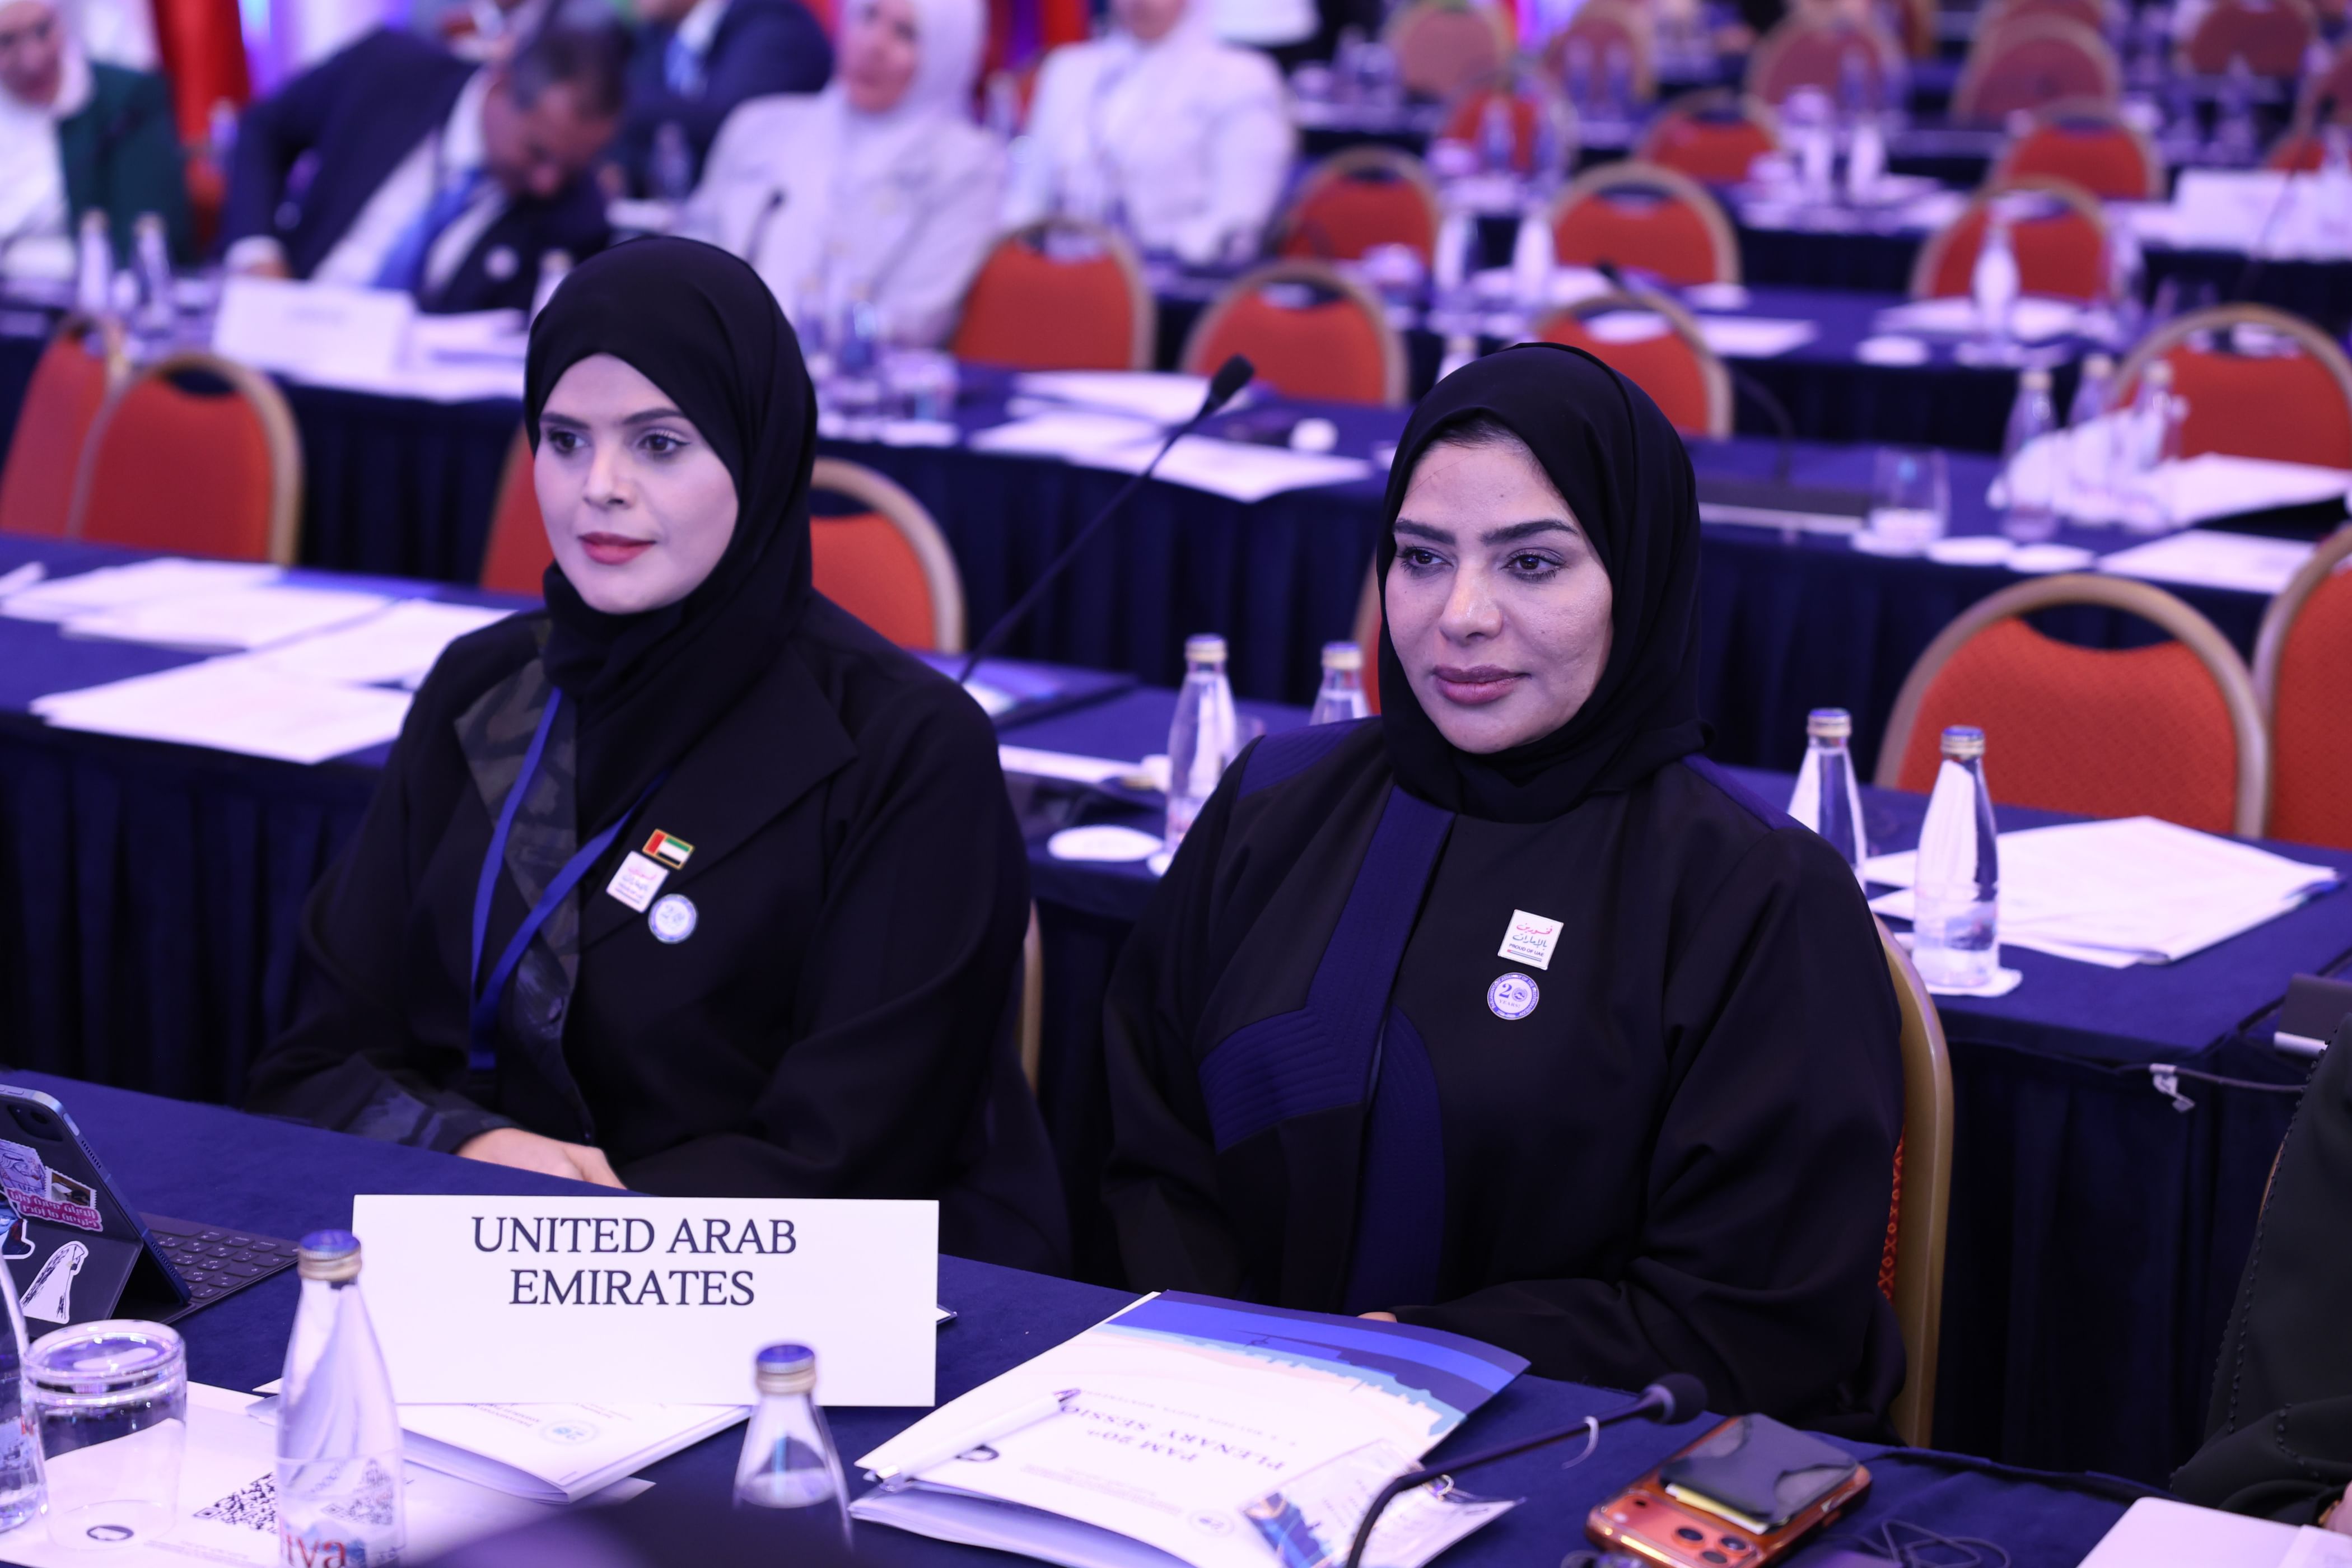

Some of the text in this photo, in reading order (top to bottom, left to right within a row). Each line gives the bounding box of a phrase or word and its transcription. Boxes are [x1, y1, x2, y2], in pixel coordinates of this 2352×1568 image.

[1509, 943, 1526, 951] PROUD
[472, 1216, 797, 1254] UNITED ARAB
[509, 1269, 755, 1306] EMIRATES
[1058, 1406, 1152, 1433] SESSIO
[1137, 1440, 1200, 1464] PAM
[1159, 1429, 1287, 1472] PLENARY
